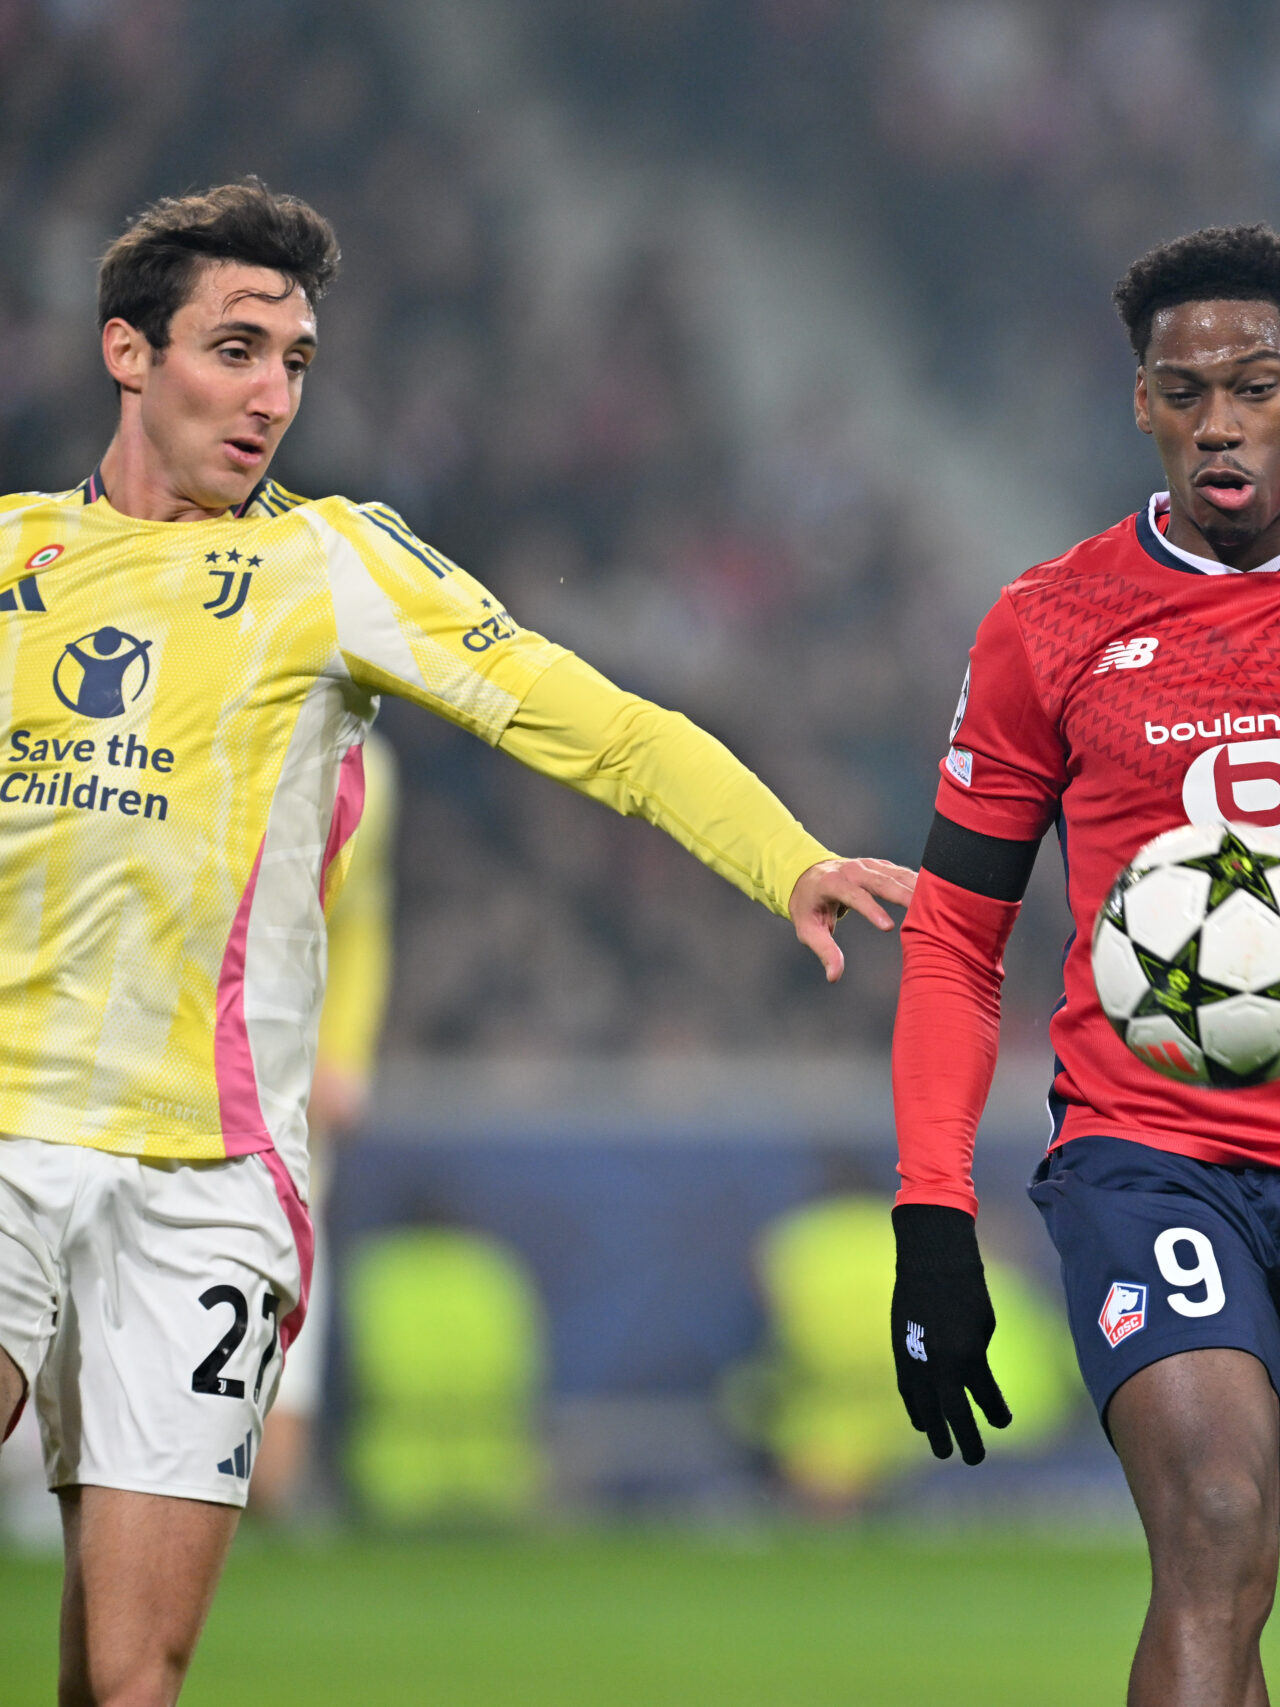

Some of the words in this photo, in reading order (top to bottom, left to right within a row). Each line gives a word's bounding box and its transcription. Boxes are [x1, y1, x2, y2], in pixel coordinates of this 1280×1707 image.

[8, 729, 96, 762] Save
[107, 733, 175, 773] the
[0, 771, 168, 821] Children
[1154, 1227, 1226, 1318] 9
[1111, 1316, 1140, 1341] LOSC
